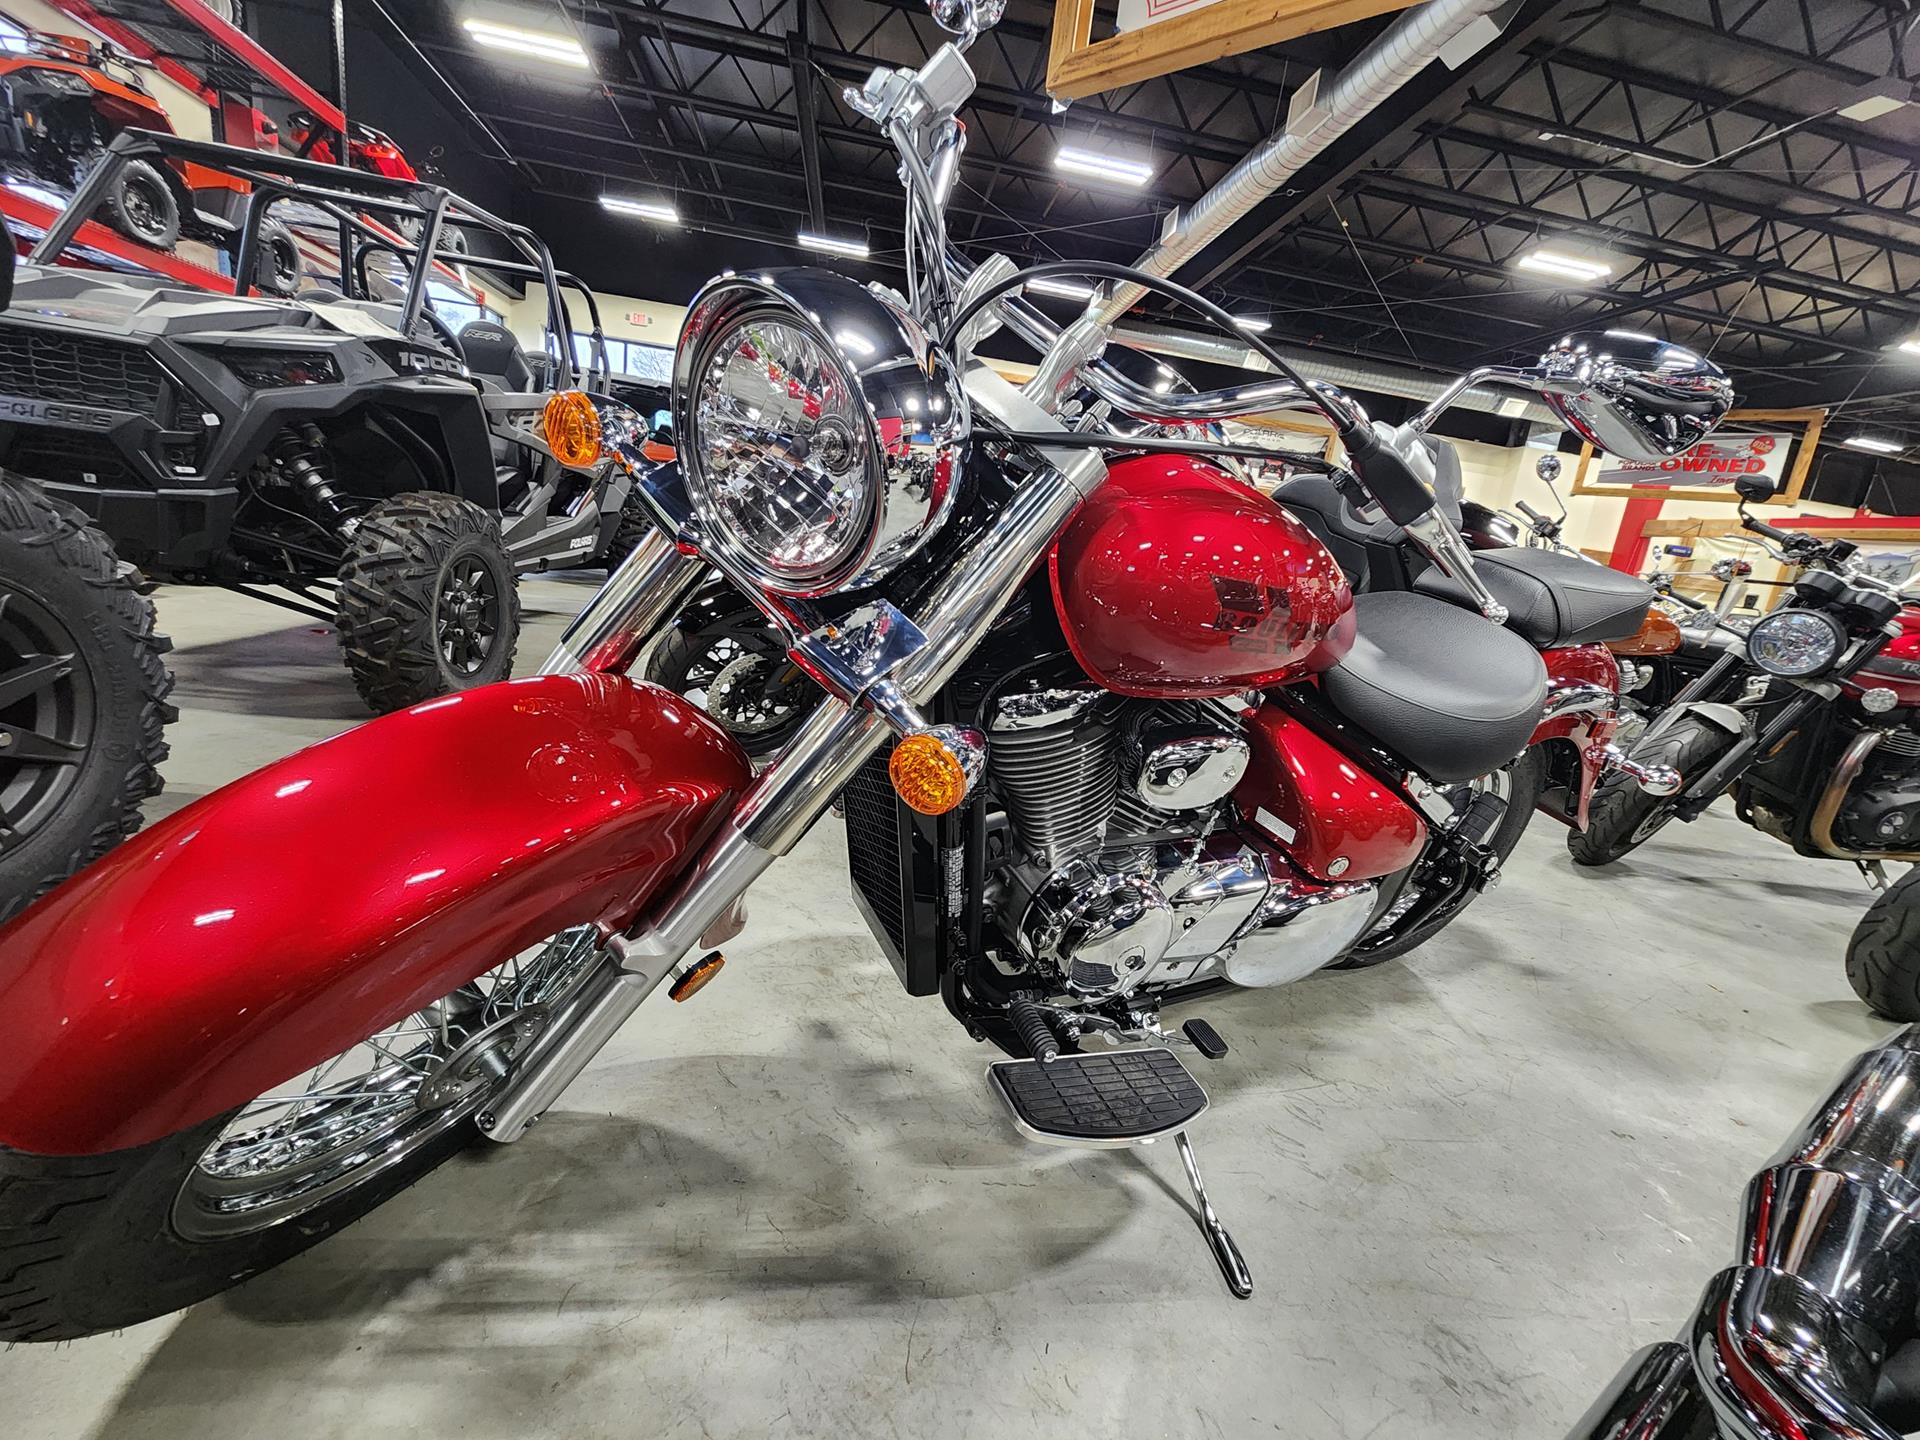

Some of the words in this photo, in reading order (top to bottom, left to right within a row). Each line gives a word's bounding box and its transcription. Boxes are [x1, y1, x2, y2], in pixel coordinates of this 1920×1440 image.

[463, 328, 503, 342] RZR
[398, 351, 462, 373] 1000
[1660, 457, 1766, 474] OWNED
[570, 535, 593, 549] POLARIS
[1901, 661, 1920, 675] TR
